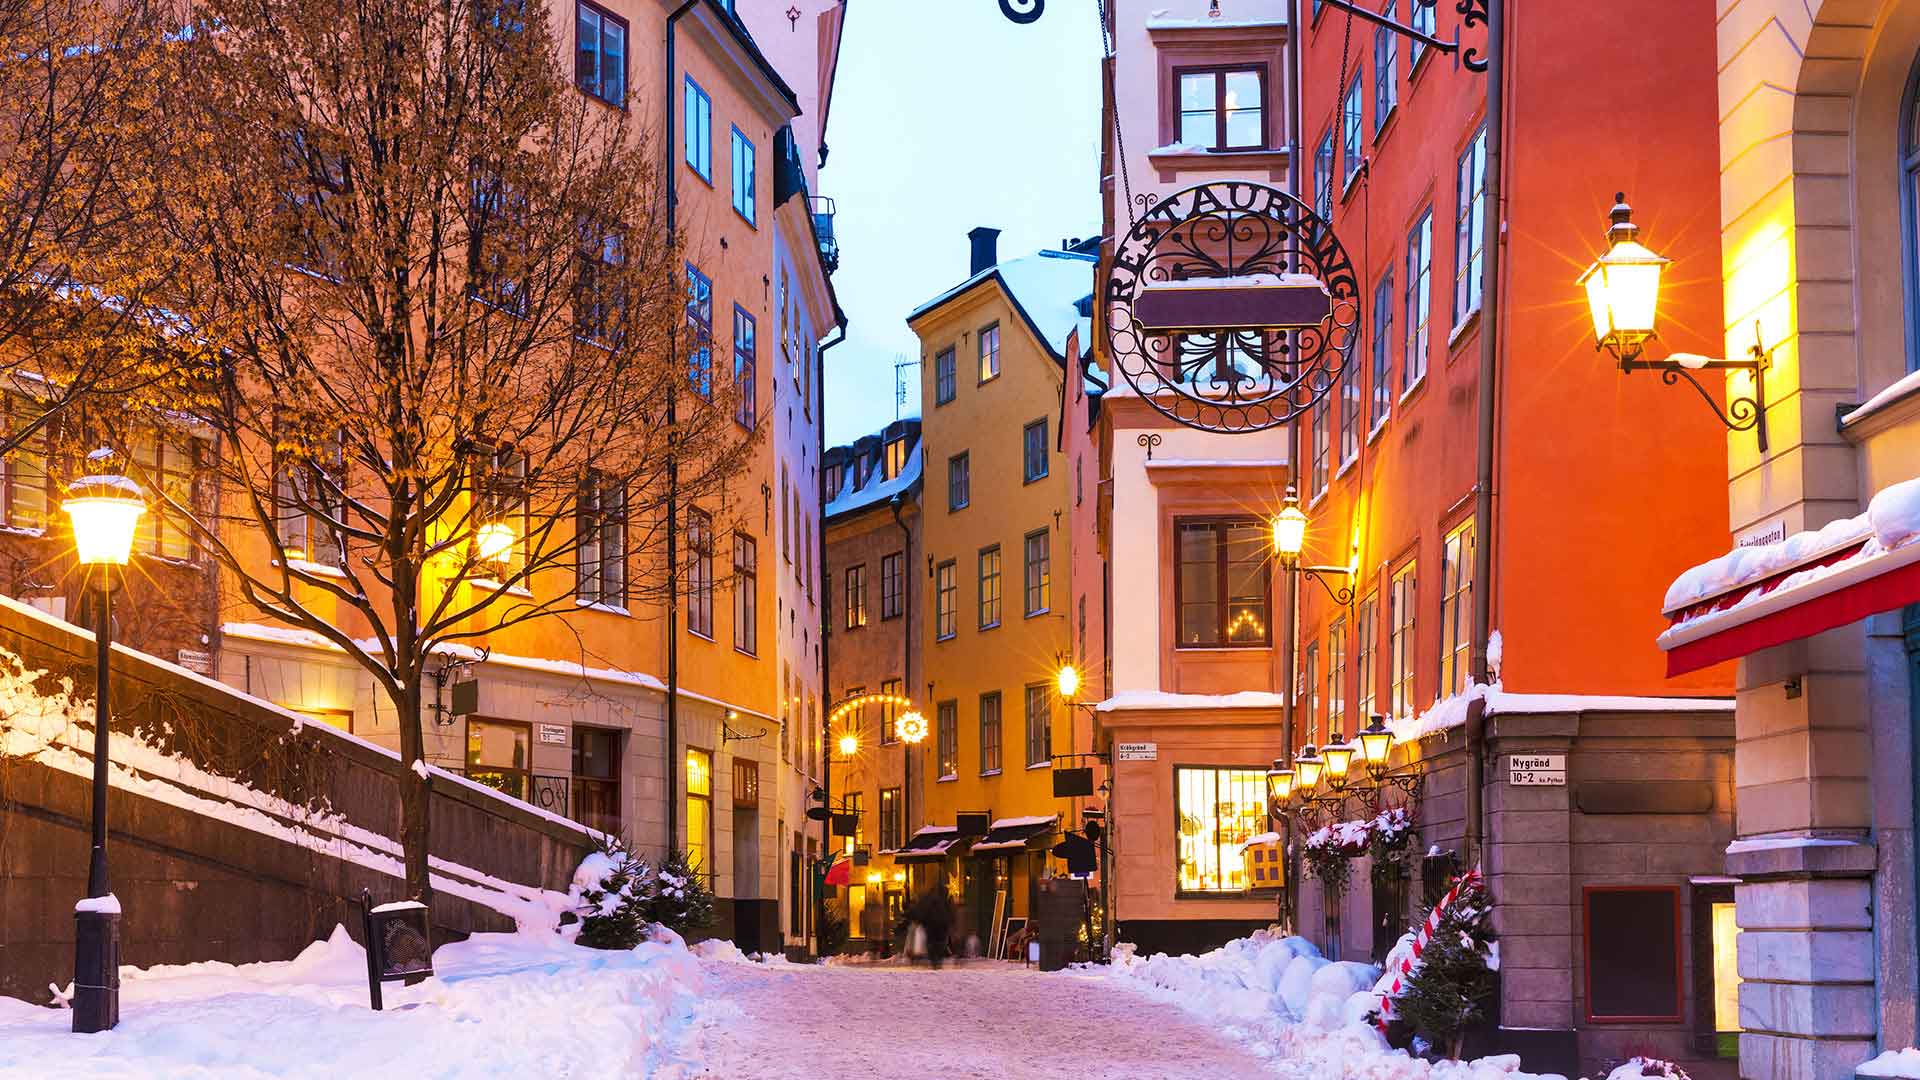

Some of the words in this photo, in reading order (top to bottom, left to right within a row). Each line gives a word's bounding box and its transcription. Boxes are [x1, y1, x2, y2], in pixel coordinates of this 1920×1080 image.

[1111, 184, 1357, 306] RESTAURANG
[1513, 758, 1550, 769] Nygränd
[1513, 772, 1534, 783] 10-2
